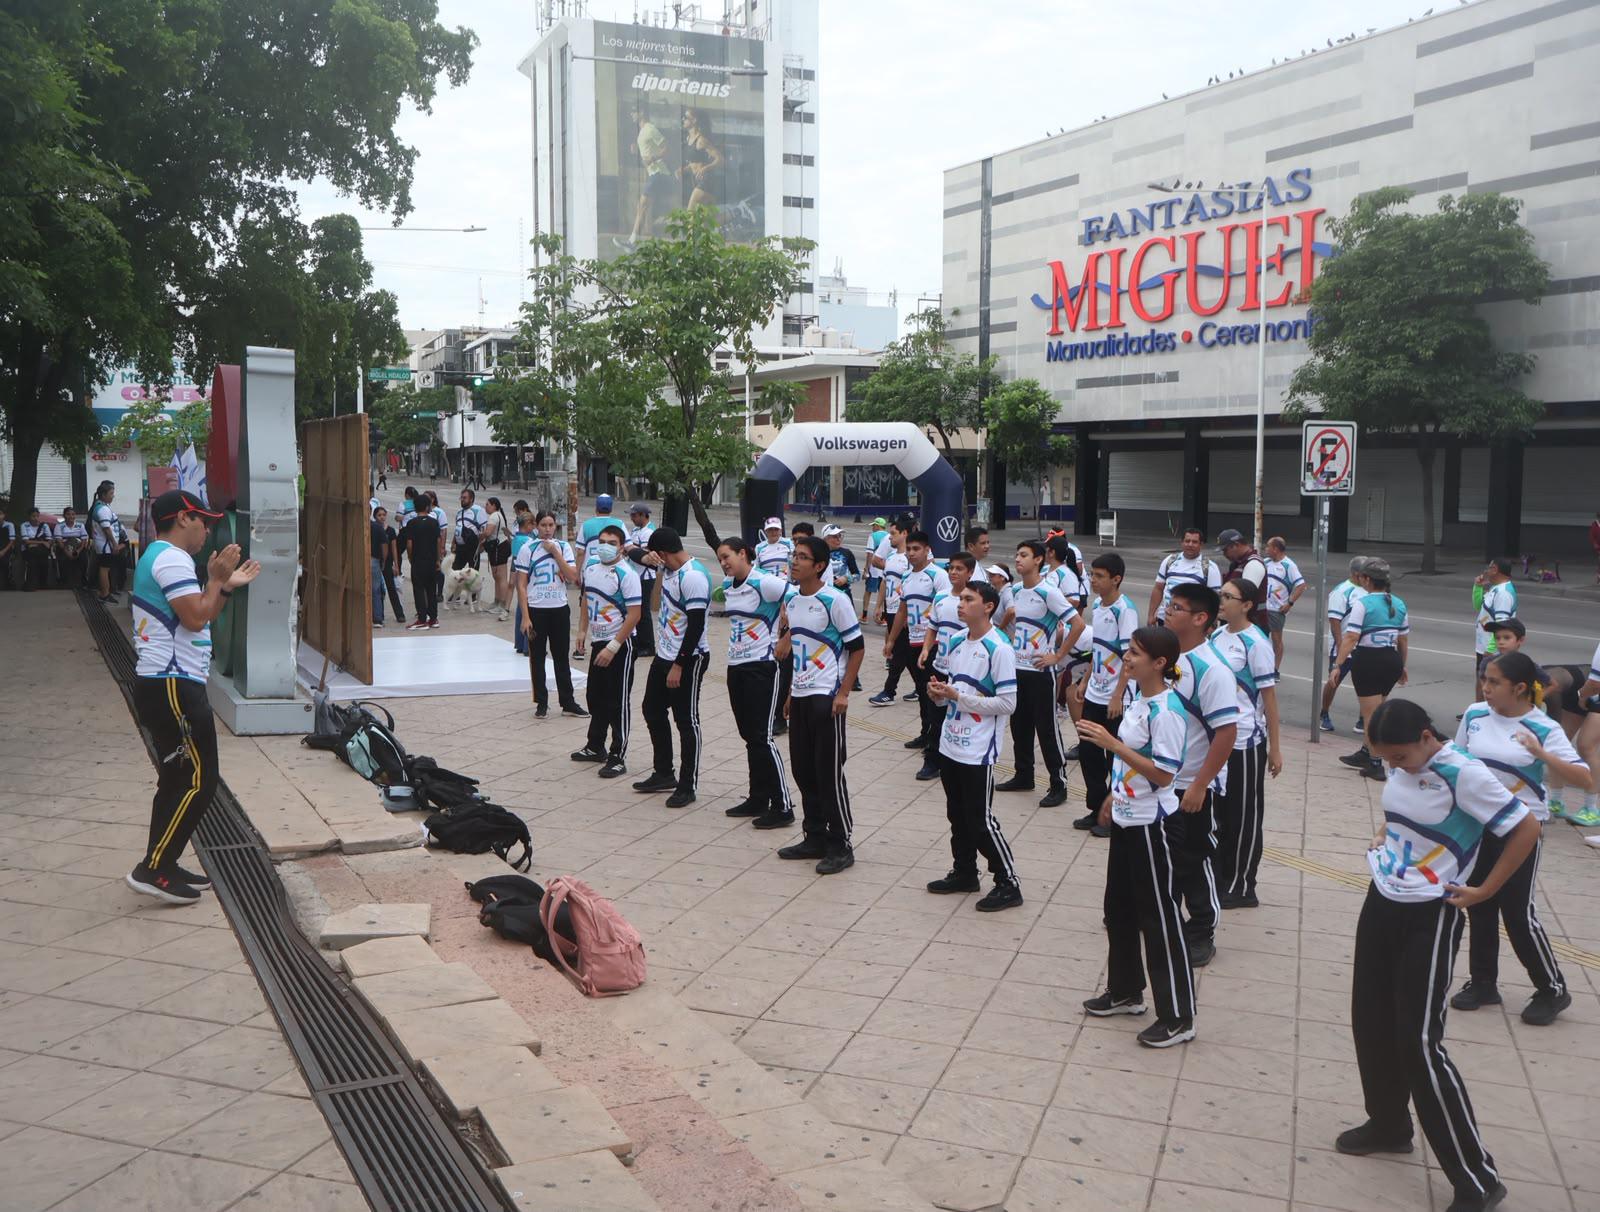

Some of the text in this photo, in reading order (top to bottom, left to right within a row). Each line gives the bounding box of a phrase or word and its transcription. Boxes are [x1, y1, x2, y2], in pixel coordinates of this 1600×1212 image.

[602, 34, 696, 56] Los mejores tenis
[631, 72, 732, 98] dportenis
[1081, 167, 1312, 247] FANTASIAS
[1046, 309, 1316, 363] Manualidades Ceremoni
[813, 436, 908, 452] Volkswagen
